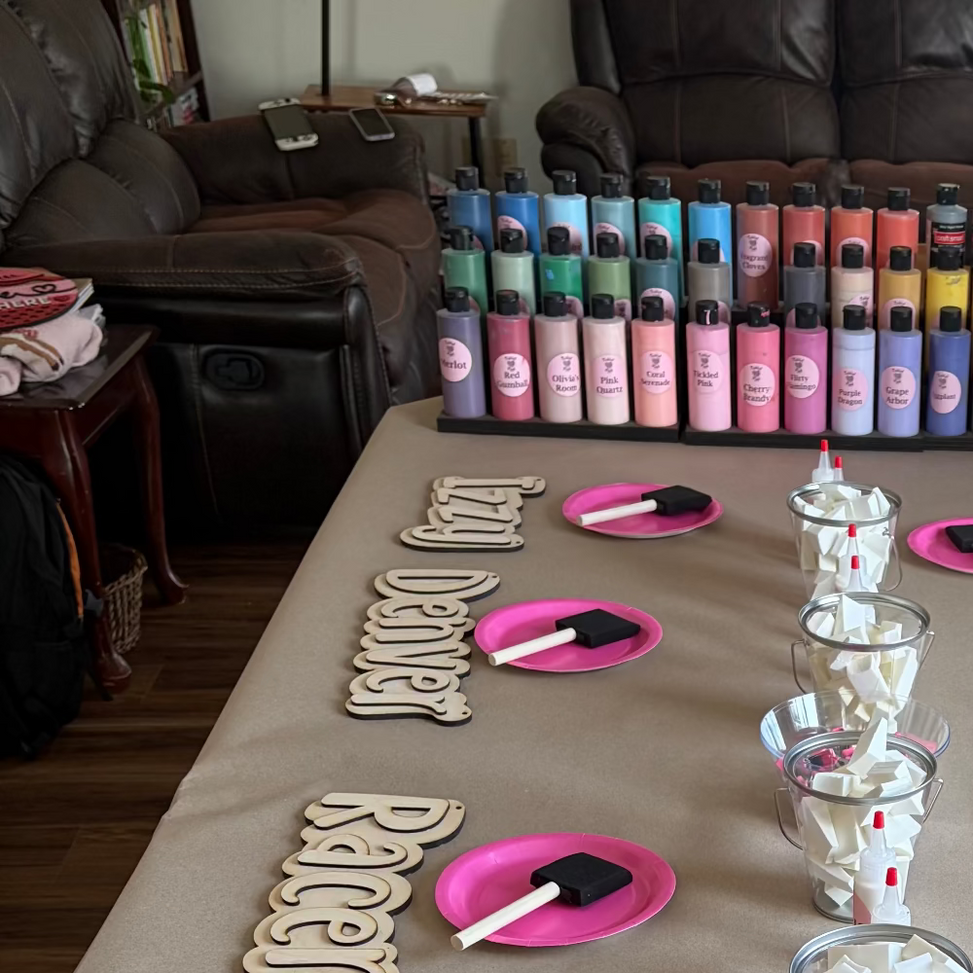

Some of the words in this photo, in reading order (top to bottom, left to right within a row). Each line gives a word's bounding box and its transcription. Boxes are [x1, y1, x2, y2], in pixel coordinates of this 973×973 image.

[742, 263, 766, 271] Cloves
[504, 371, 520, 379] Red
[693, 369, 719, 379] Tickled
[600, 376, 619, 385] Pink
[697, 379, 713, 387] Pink
[596, 385, 623, 394] Quartz
[743, 383, 771, 394] Cherry
[885, 386, 909, 396] Grape
[743, 393, 771, 403] Brandy
[839, 389, 861, 398] Purple
[837, 397, 863, 406] Dragon
[886, 396, 909, 405] Arbor
[410, 477, 538, 547] Izzy
[350, 568, 489, 716] Denver
